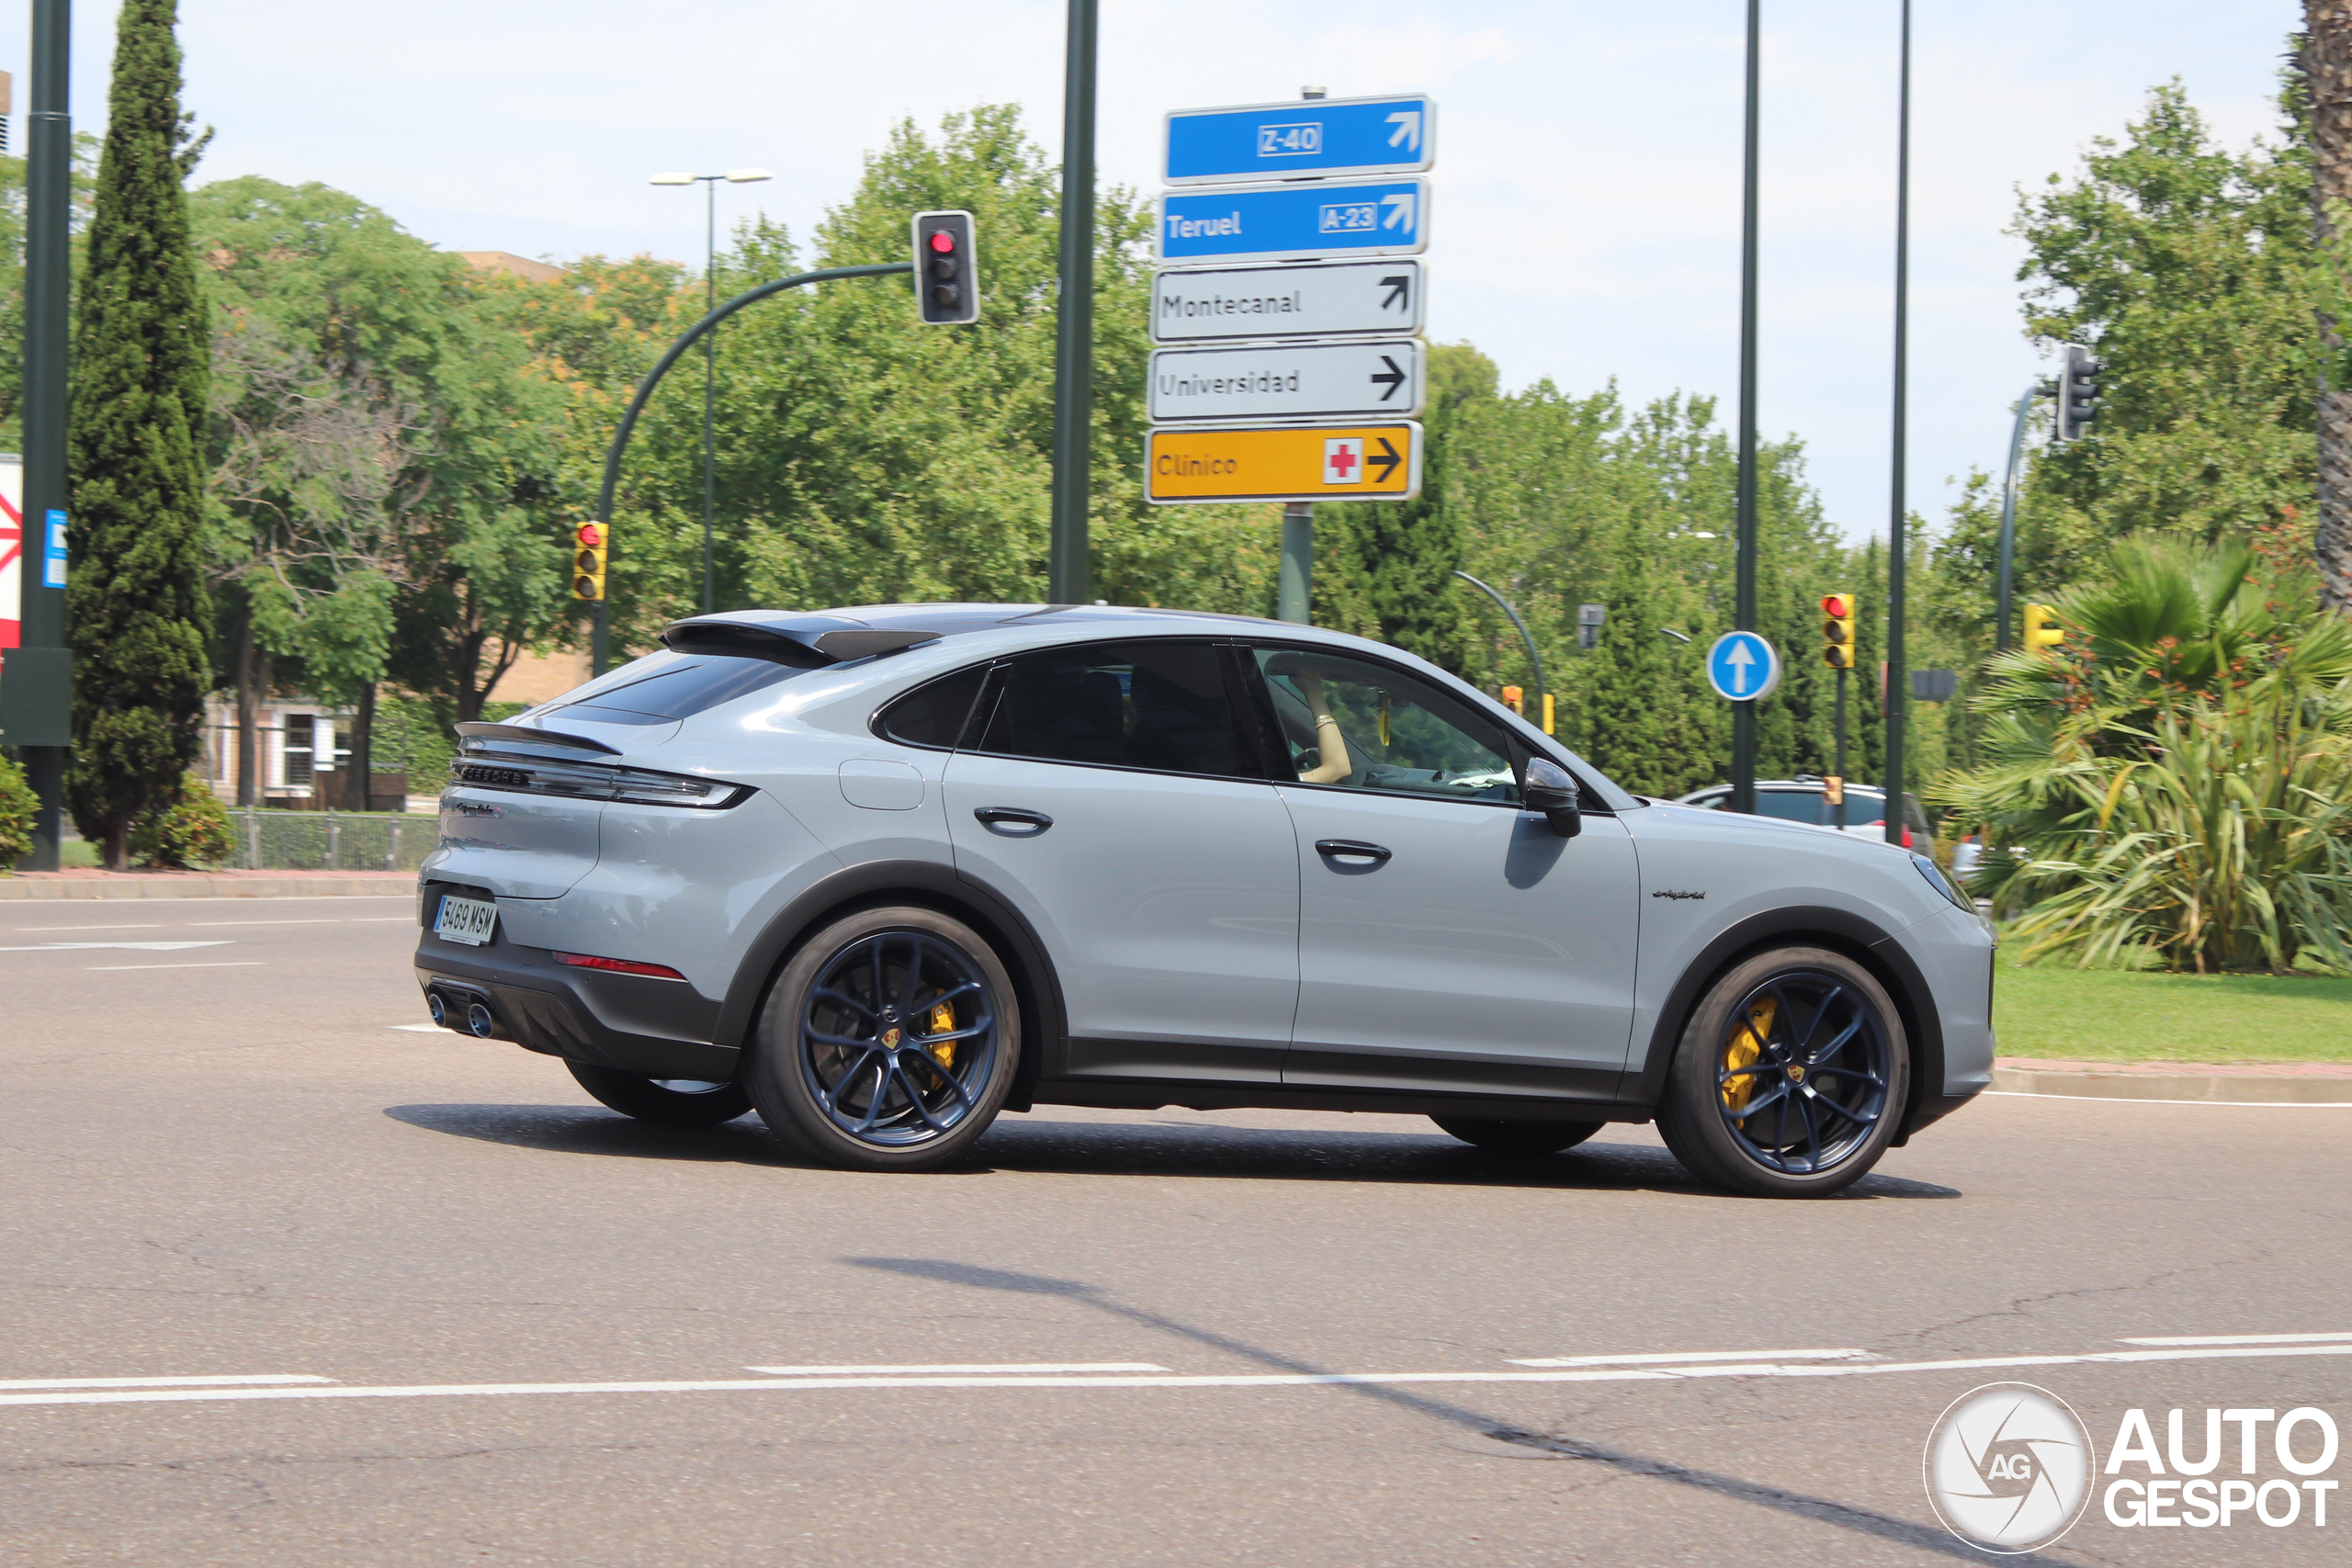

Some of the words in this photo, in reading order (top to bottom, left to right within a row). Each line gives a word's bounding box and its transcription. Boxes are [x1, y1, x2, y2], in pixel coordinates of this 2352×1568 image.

[1261, 127, 1319, 152] Z-40
[1166, 210, 1242, 239] Teruel
[1323, 207, 1374, 230] A-23
[1161, 290, 1302, 319] Montecanal
[1159, 370, 1300, 397] Universidad
[442, 901, 469, 931] 5469
[469, 905, 494, 935] MSM
